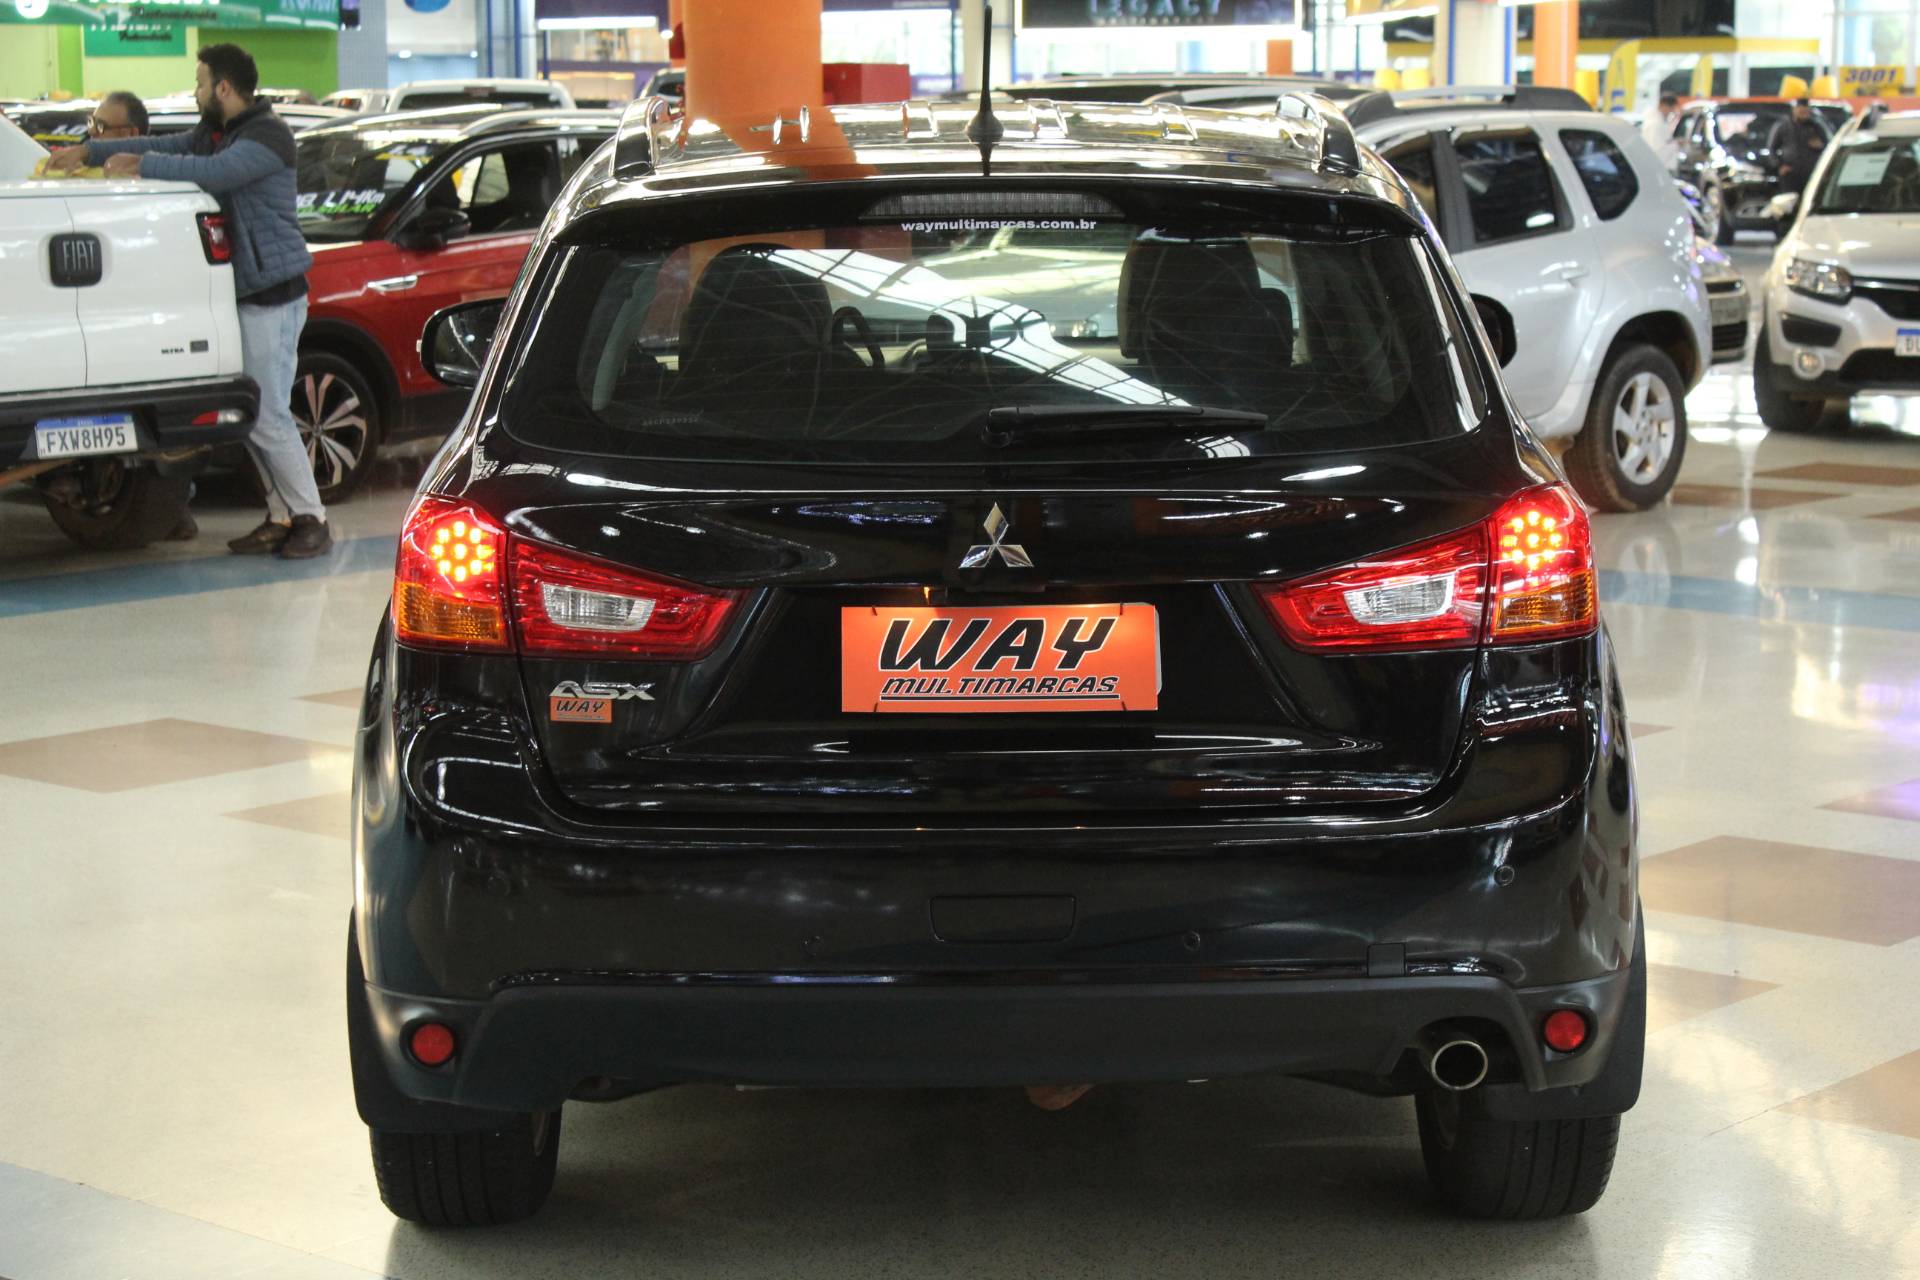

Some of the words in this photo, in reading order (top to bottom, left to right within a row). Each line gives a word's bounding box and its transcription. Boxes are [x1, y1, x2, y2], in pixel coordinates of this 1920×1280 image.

[901, 218, 1097, 233] waymultimarcas.com.br
[63, 240, 95, 271] FIAT
[46, 427, 125, 452] FXW8H95
[879, 617, 1118, 671] WAY
[549, 680, 655, 700] ASX
[882, 676, 1119, 694] MULTIMARCAS
[556, 700, 605, 713] WAY
